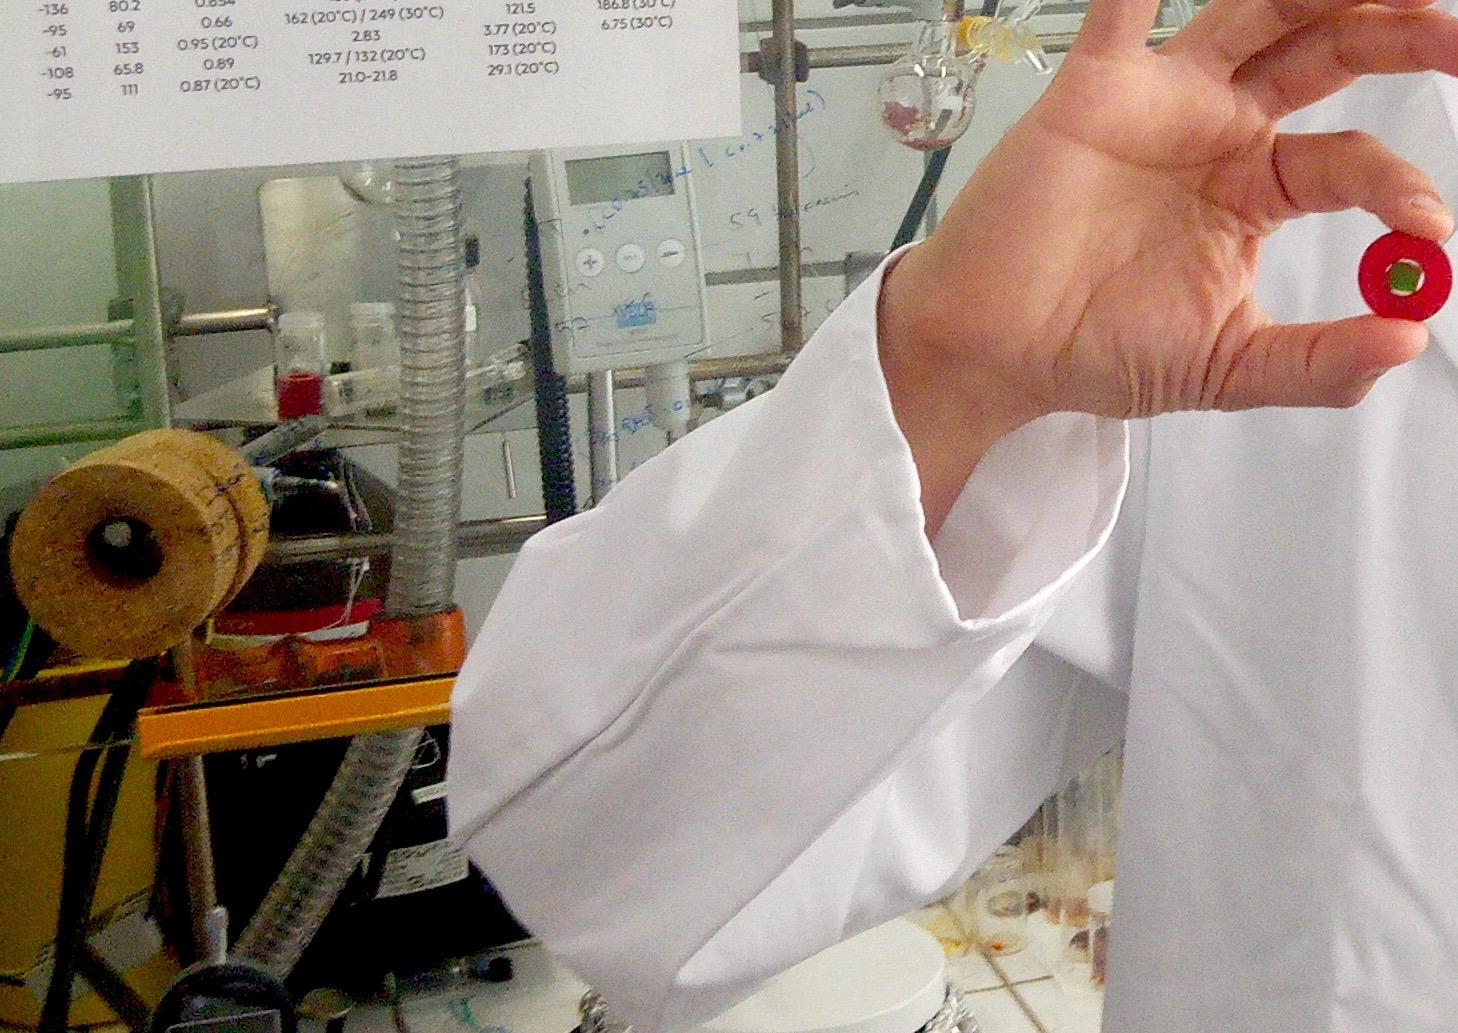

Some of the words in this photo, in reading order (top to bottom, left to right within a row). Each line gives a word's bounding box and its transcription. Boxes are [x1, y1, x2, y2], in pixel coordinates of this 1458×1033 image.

[38, 3, 69, 16] -136
[284, 12, 309, 25] 162
[310, 10, 358, 26] (20°C)
[369, 8, 397, 21] 249
[397, 6, 445, 21] (30°C)
[42, 24, 68, 37] -95
[116, 21, 136, 33] 69
[115, 41, 140, 54] 153
[211, 35, 259, 51] (20°C)
[487, 44, 511, 56] 173
[511, 41, 557, 56] (20°C)
[47, 45, 67, 58] -61
[354, 50, 378, 62] 132
[379, 47, 427, 63] (20°C)
[41, 66, 75, 79] -108
[121, 83, 139, 96] 111
[213, 76, 262, 92] (20°C)
[47, 88, 72, 100] -95
